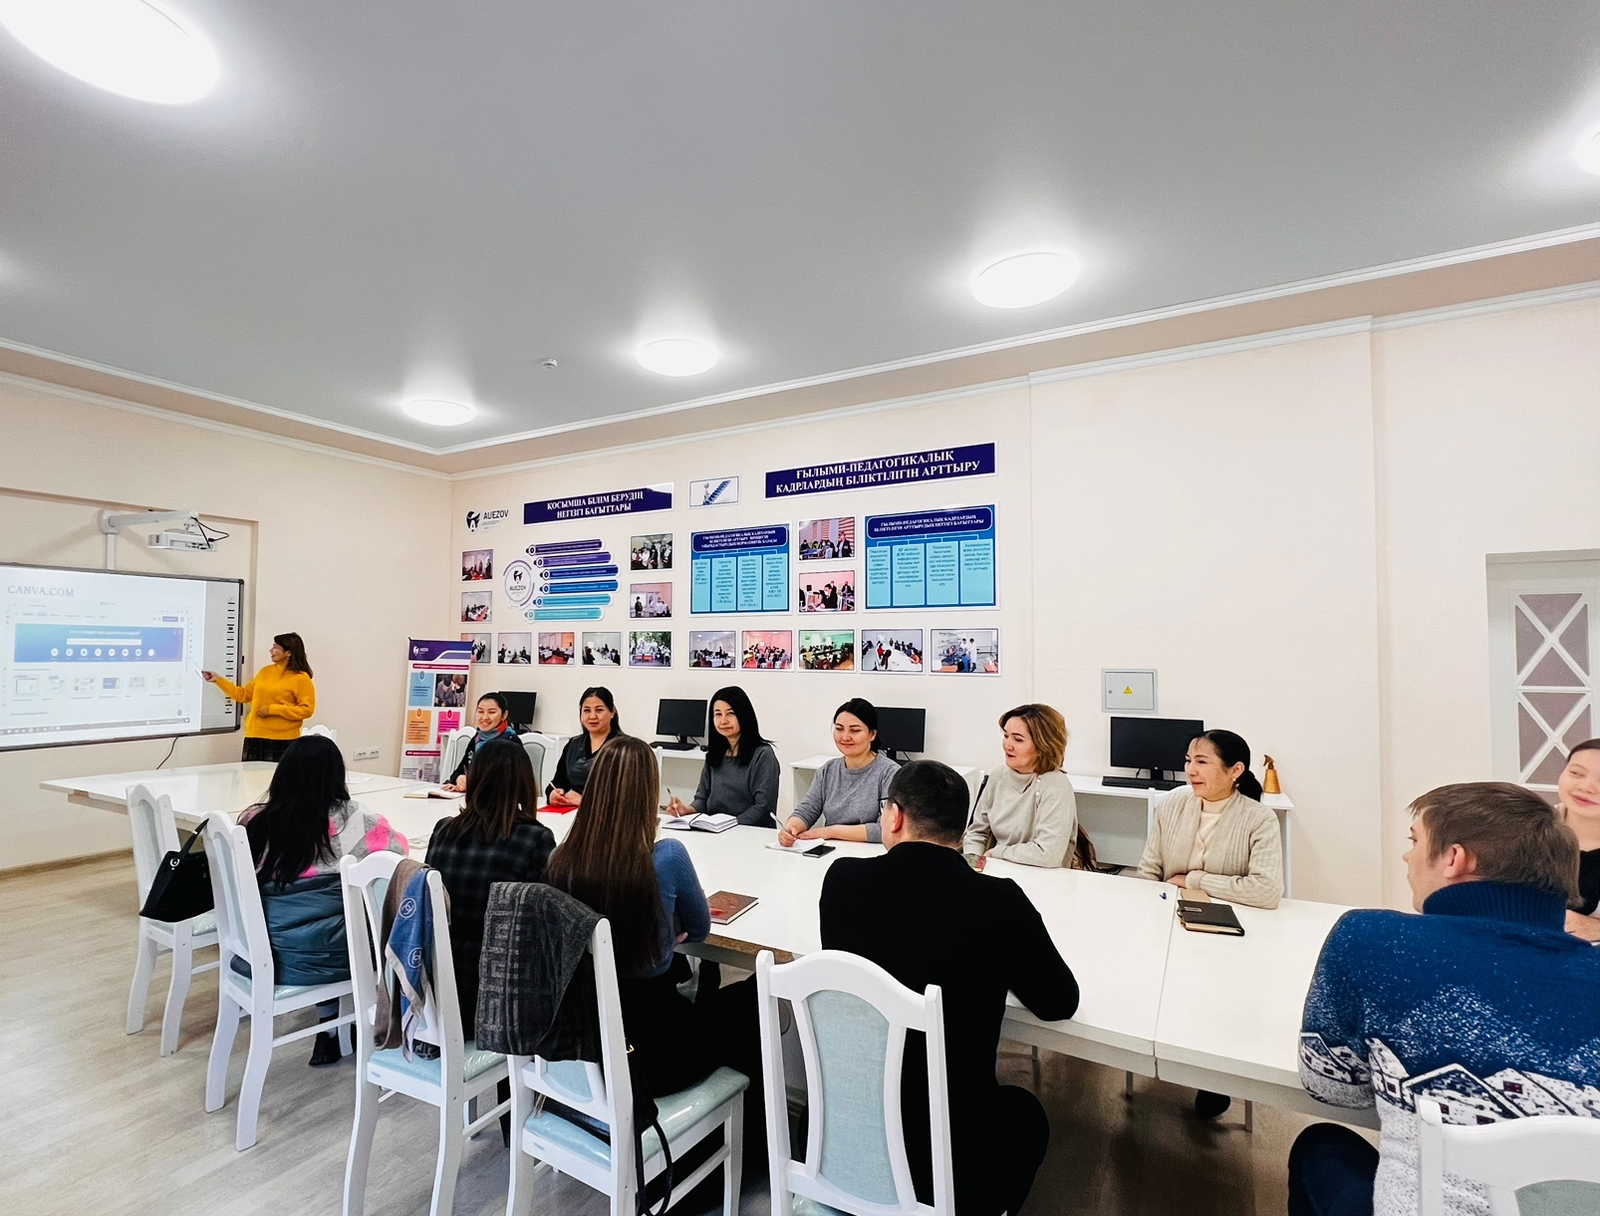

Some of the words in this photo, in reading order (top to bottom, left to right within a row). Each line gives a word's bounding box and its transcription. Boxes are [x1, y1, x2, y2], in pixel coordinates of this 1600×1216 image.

[776, 475, 843, 493] КАДРЛАРДЫҢ
[846, 467, 919, 485] БІЛІКТІЛІГІН
[921, 460, 980, 477] АРТТЫРУ
[547, 498, 586, 510] ҚОСЫМША
[483, 509, 509, 520] AUEZOV
[7, 584, 75, 597] CANVA.COM
